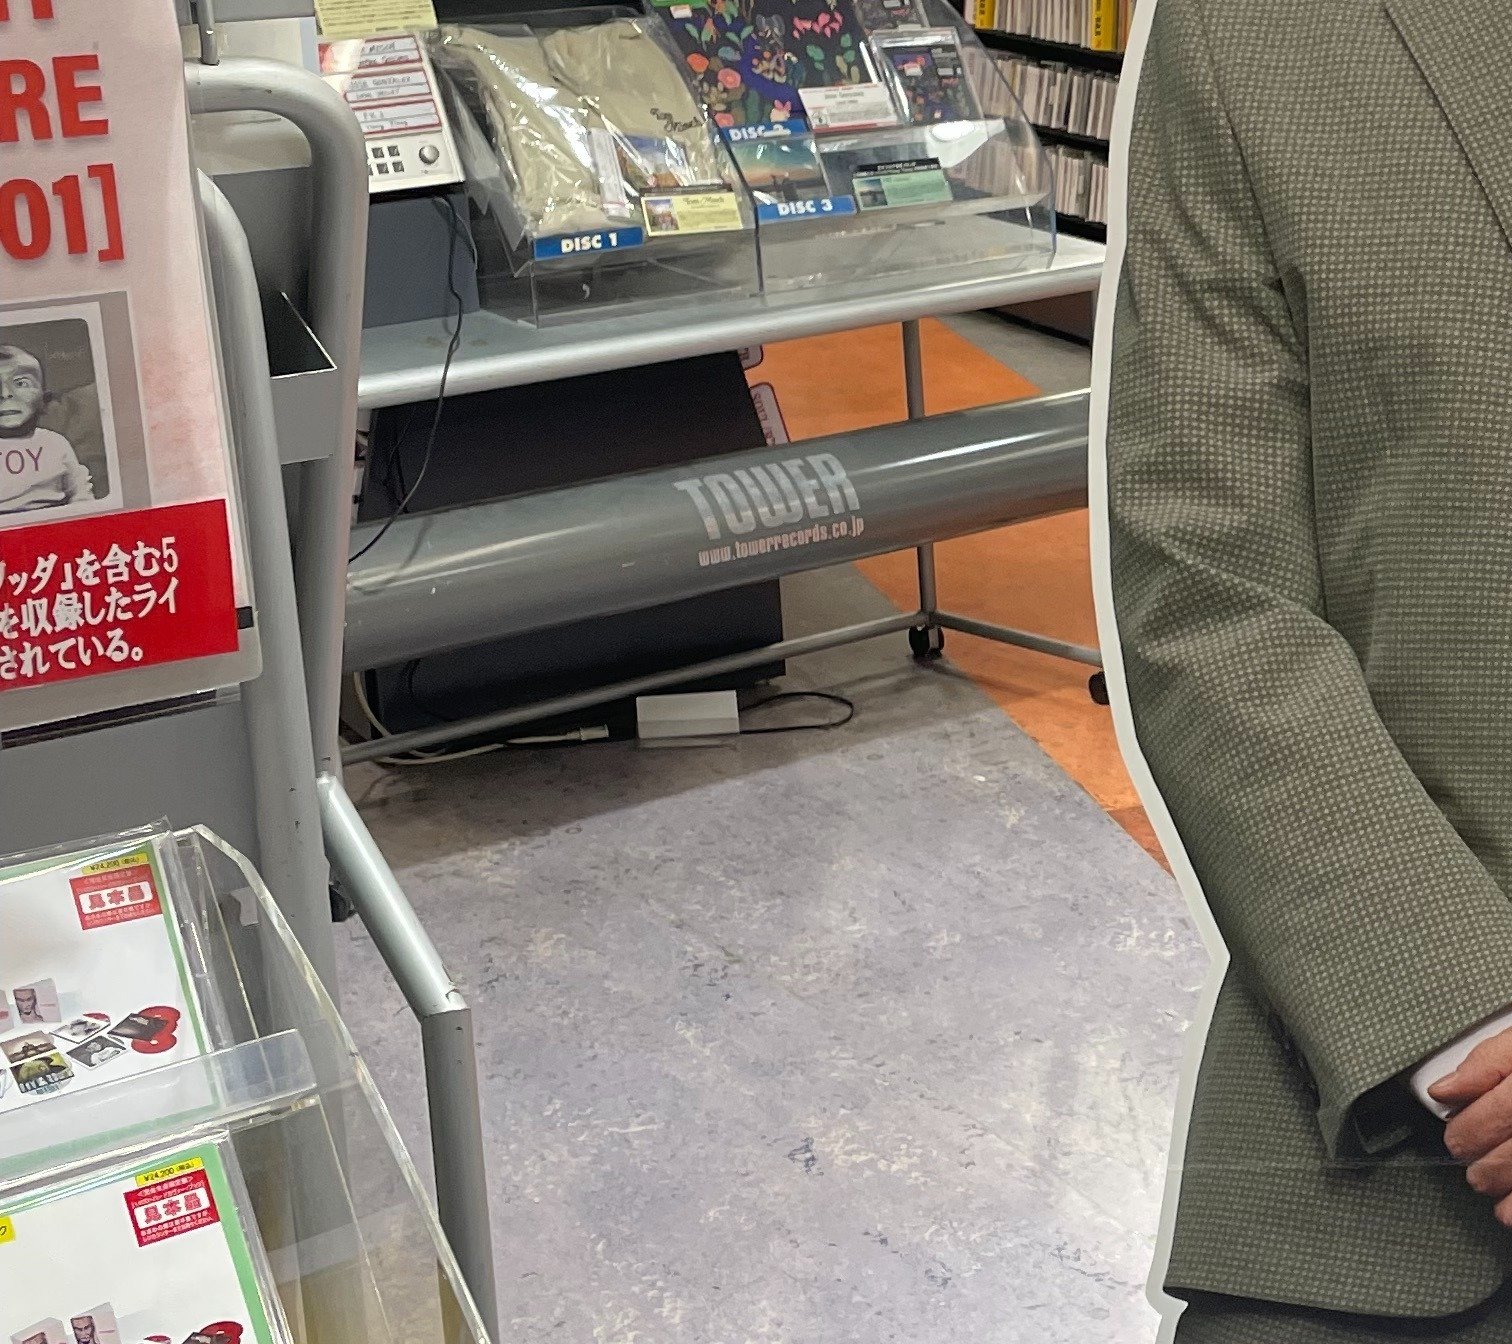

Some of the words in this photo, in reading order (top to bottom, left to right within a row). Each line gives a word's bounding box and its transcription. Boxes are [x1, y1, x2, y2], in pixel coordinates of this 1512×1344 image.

[778, 200, 816, 217] DISC
[821, 199, 833, 212] 3
[561, 235, 602, 254] DISC
[608, 232, 618, 247] 1
[0, 446, 43, 476] OY
[673, 453, 861, 541] TOWER
[698, 515, 865, 567] www.towerrecords.co.jp
[0, 536, 178, 597] ッダ』を含む5
